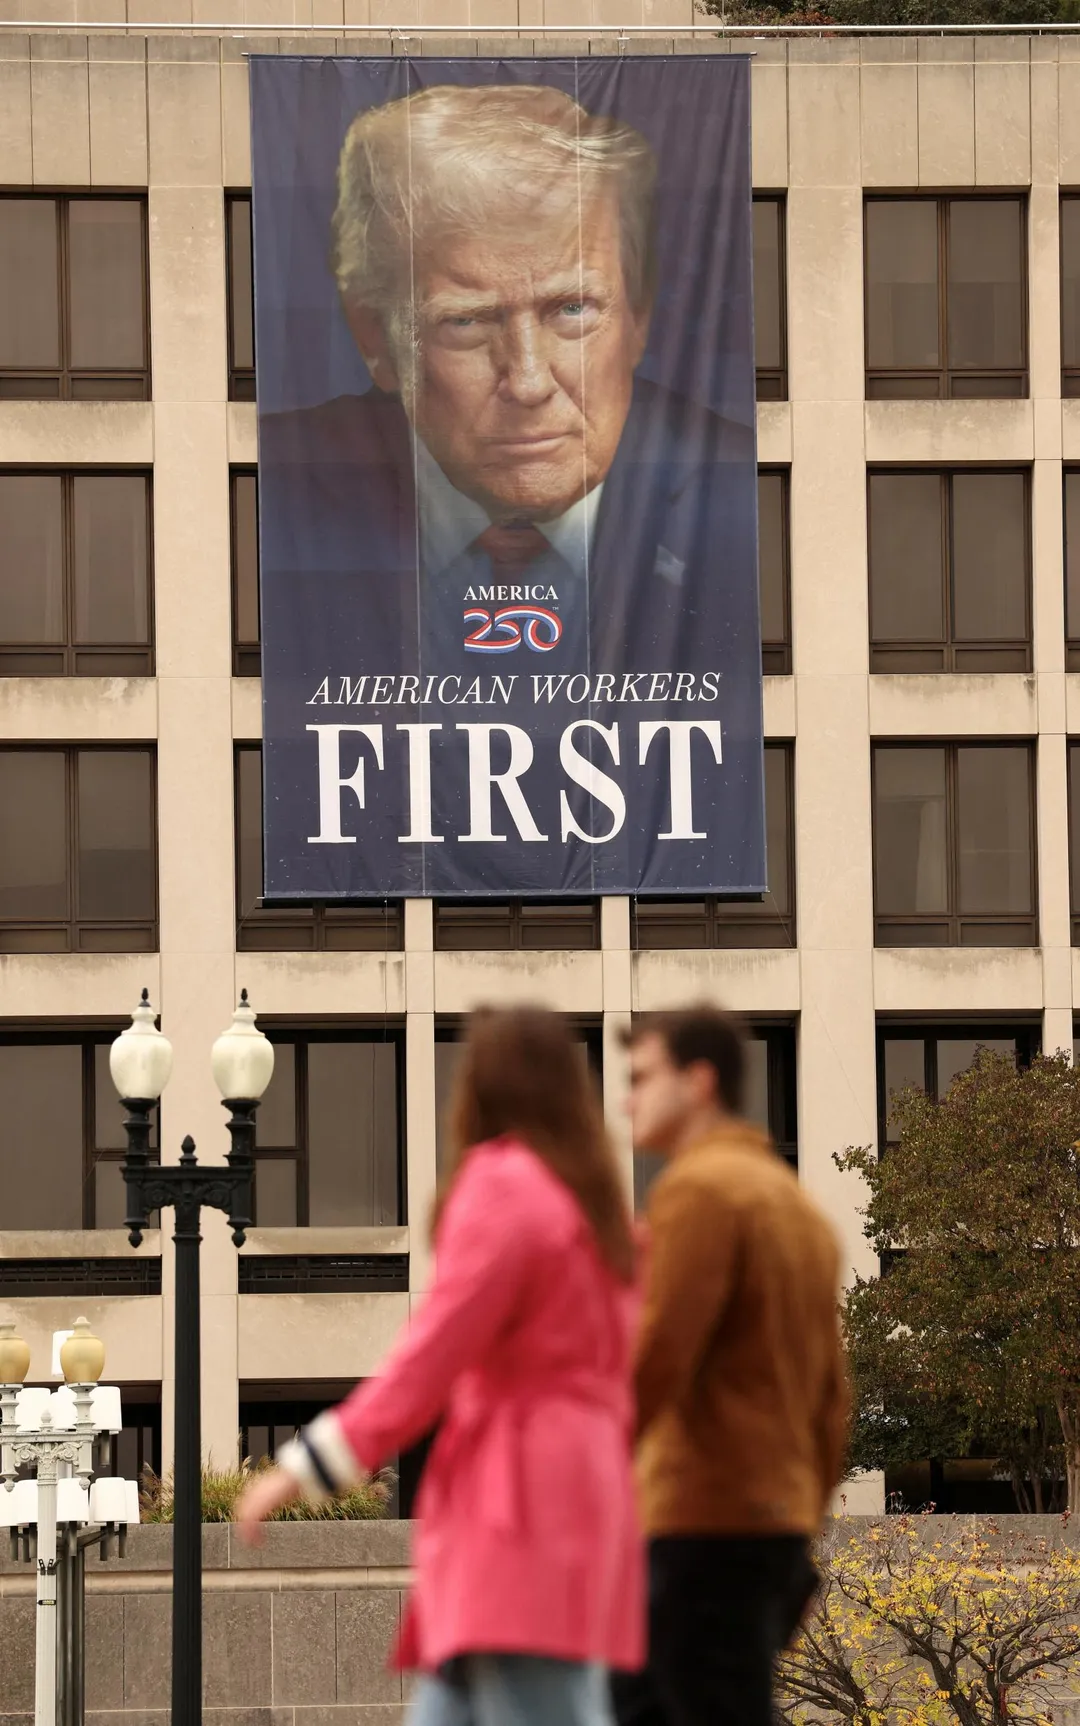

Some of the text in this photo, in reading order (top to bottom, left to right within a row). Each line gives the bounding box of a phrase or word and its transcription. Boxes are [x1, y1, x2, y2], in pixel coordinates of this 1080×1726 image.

[463, 584, 559, 601] AMERICA
[463, 605, 563, 654] 250
[305, 671, 721, 705] AMERICAN WORKERS
[305, 719, 723, 844] FIRST
